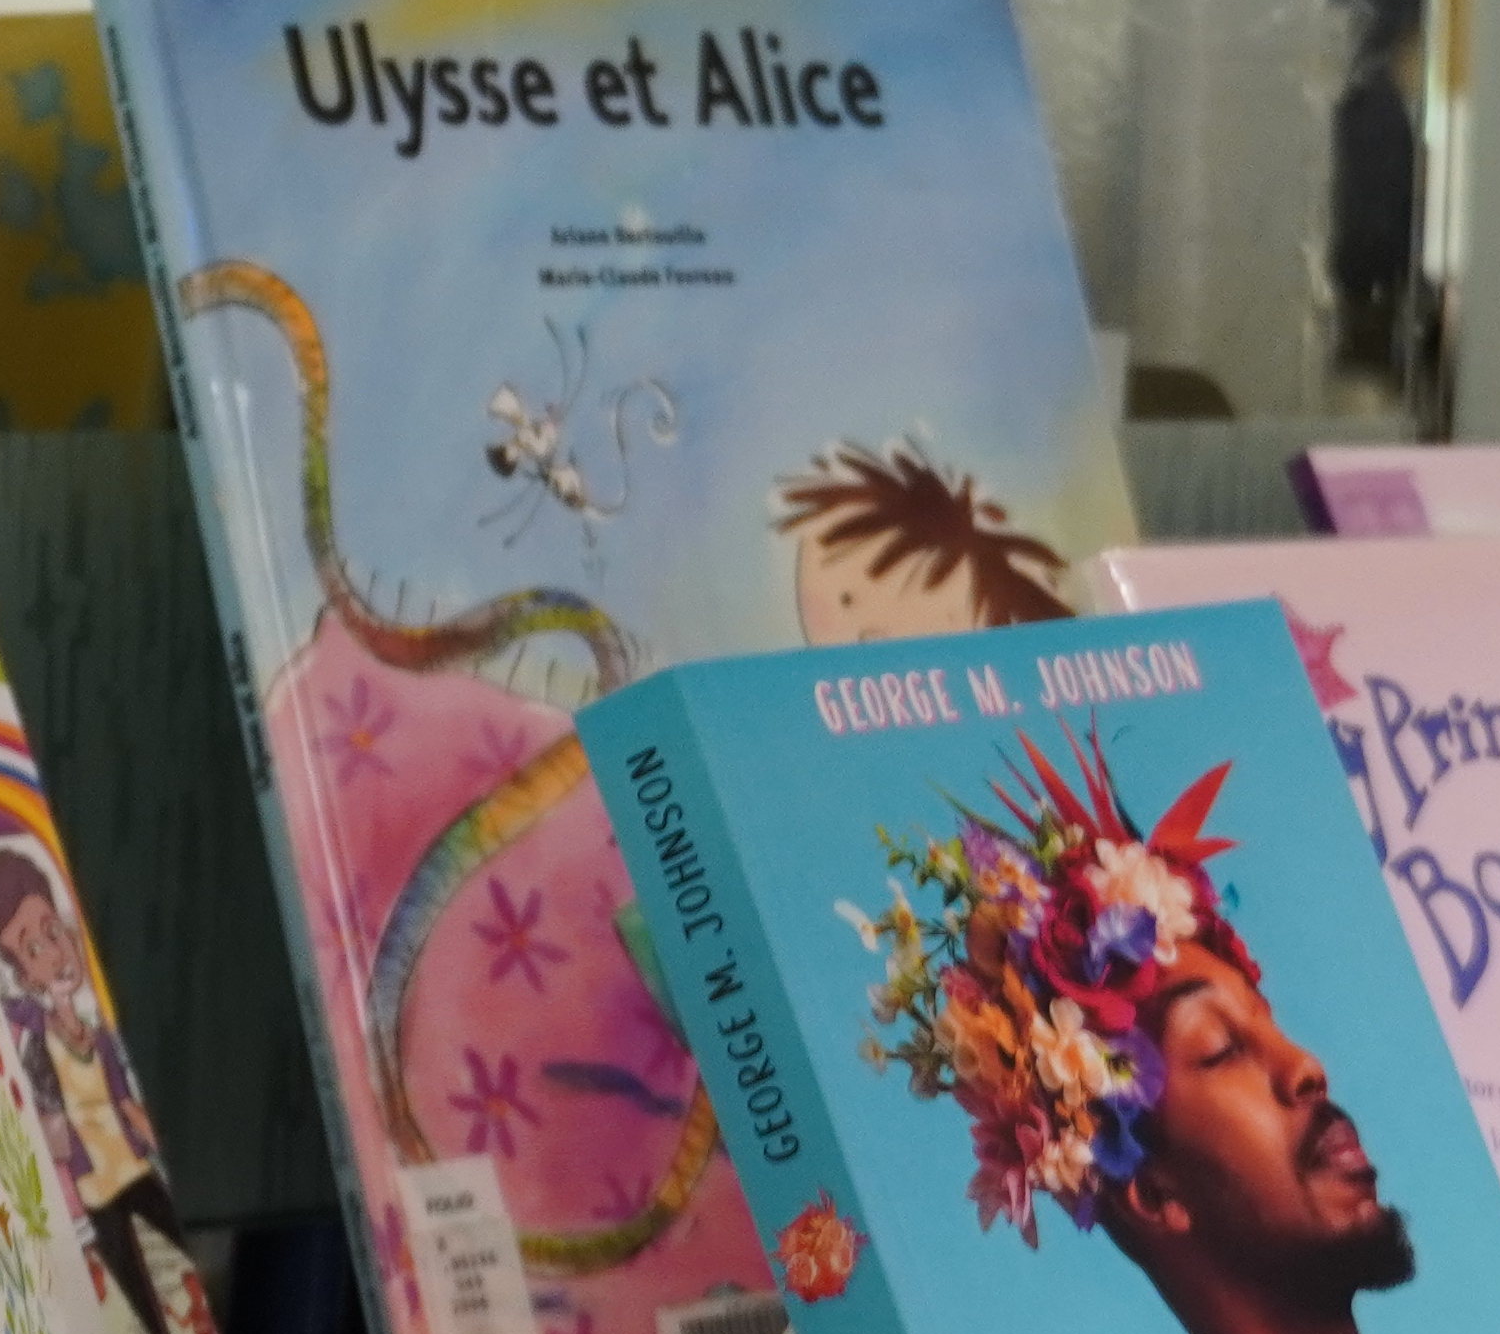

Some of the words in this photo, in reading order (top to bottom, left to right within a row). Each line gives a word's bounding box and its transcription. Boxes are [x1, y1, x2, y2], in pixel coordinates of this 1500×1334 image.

[284, 20, 559, 159] Ulysse
[587, 37, 670, 129] et
[696, 27, 885, 132] Alice
[813, 669, 960, 737] GEORGE
[966, 663, 1024, 717] M.
[1036, 641, 1202, 713] JOHNSON
[626, 745, 725, 944] JOHNSON
[703, 946, 744, 1004] M.
[715, 1008, 801, 1168] GEORGE
